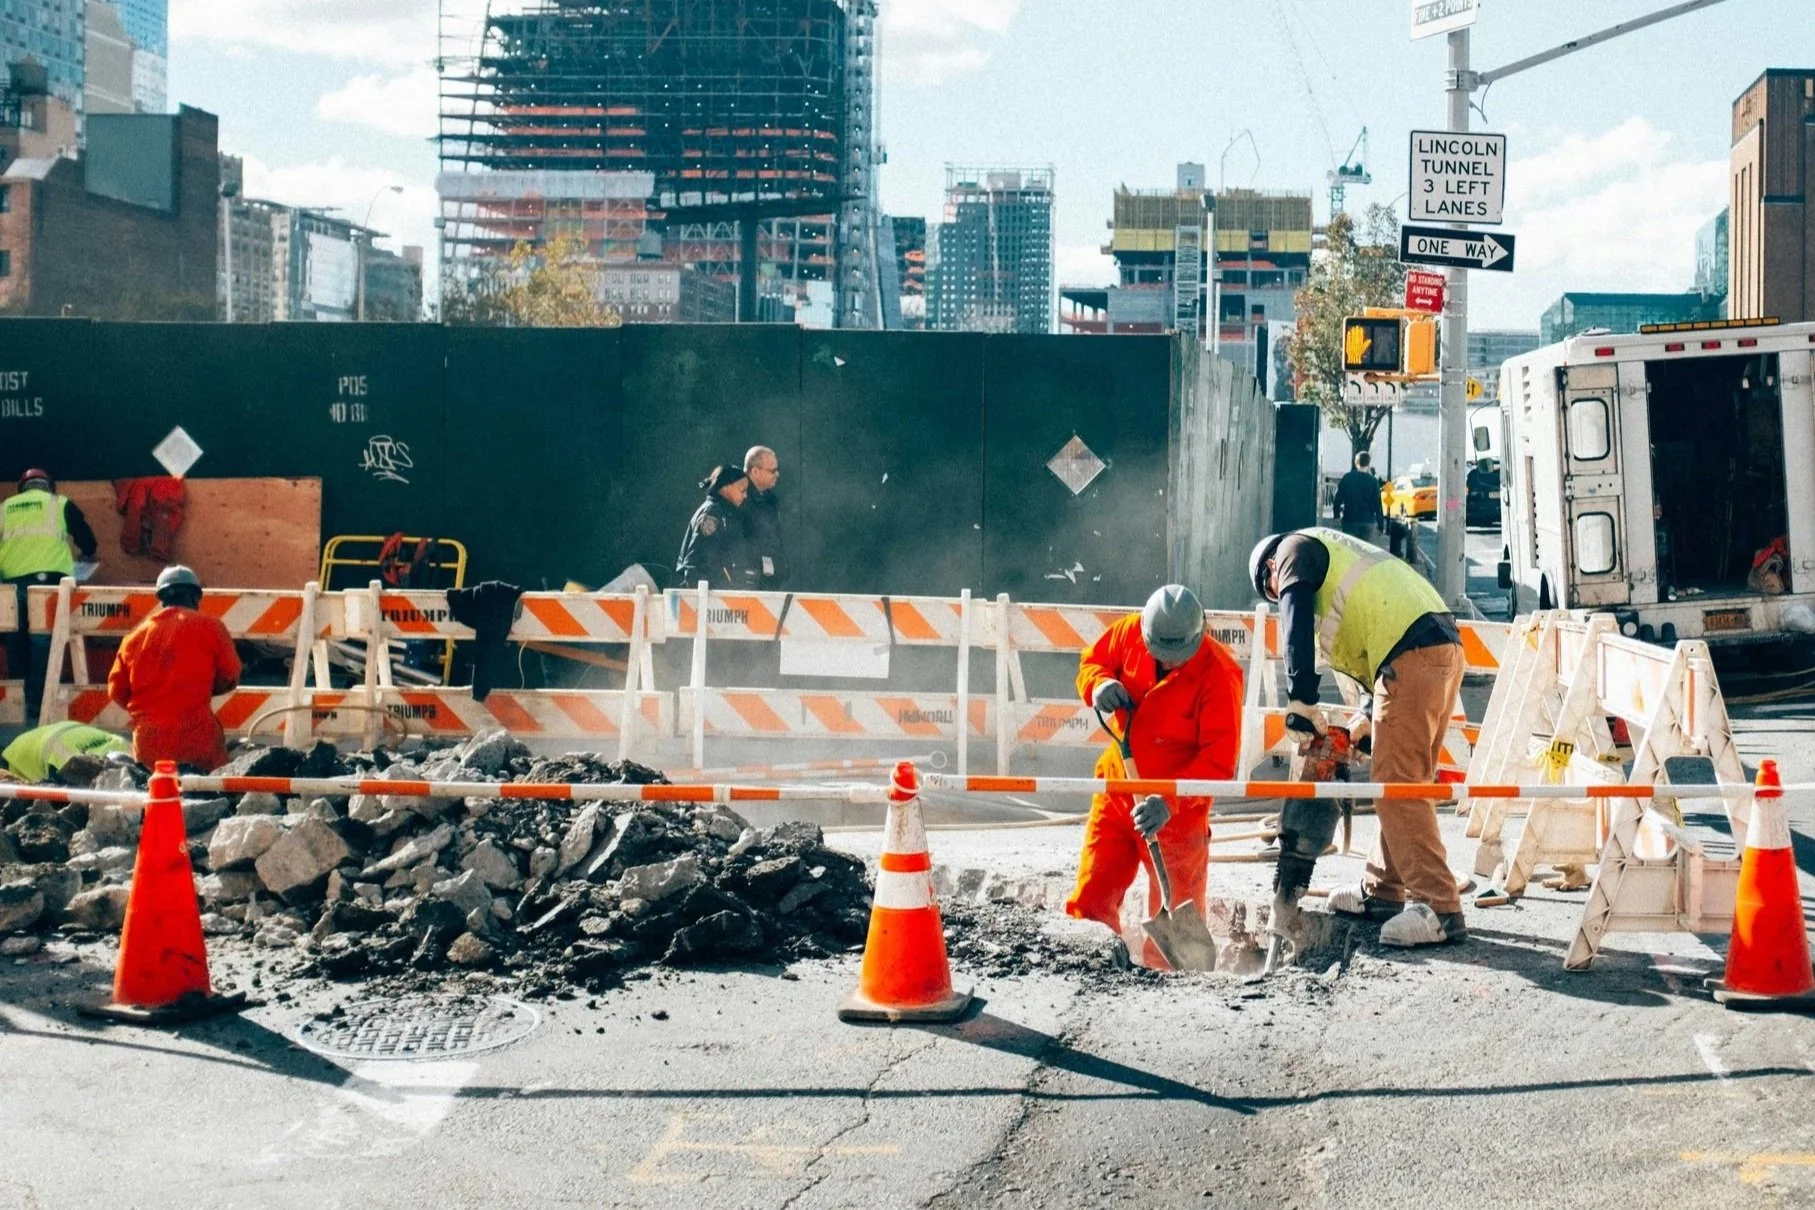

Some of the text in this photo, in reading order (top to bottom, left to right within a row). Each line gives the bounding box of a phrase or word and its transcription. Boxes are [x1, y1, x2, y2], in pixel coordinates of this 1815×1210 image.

[1419, 139, 1497, 156] LINCOLN
[1421, 159, 1494, 176] TUNNEL
[1424, 179, 1490, 195] 3 LEFT
[1426, 199, 1488, 216] LANES
[1417, 239, 1498, 259] ONE WAY
[1409, 274, 1443, 287] NO STANDING
[1412, 286, 1437, 296] ANYTIME
[0, 371, 28, 391] OST
[2, 397, 43, 418] BILLS
[81, 603, 130, 617] TRIUMPH
[706, 608, 749, 624] RIUMPH
